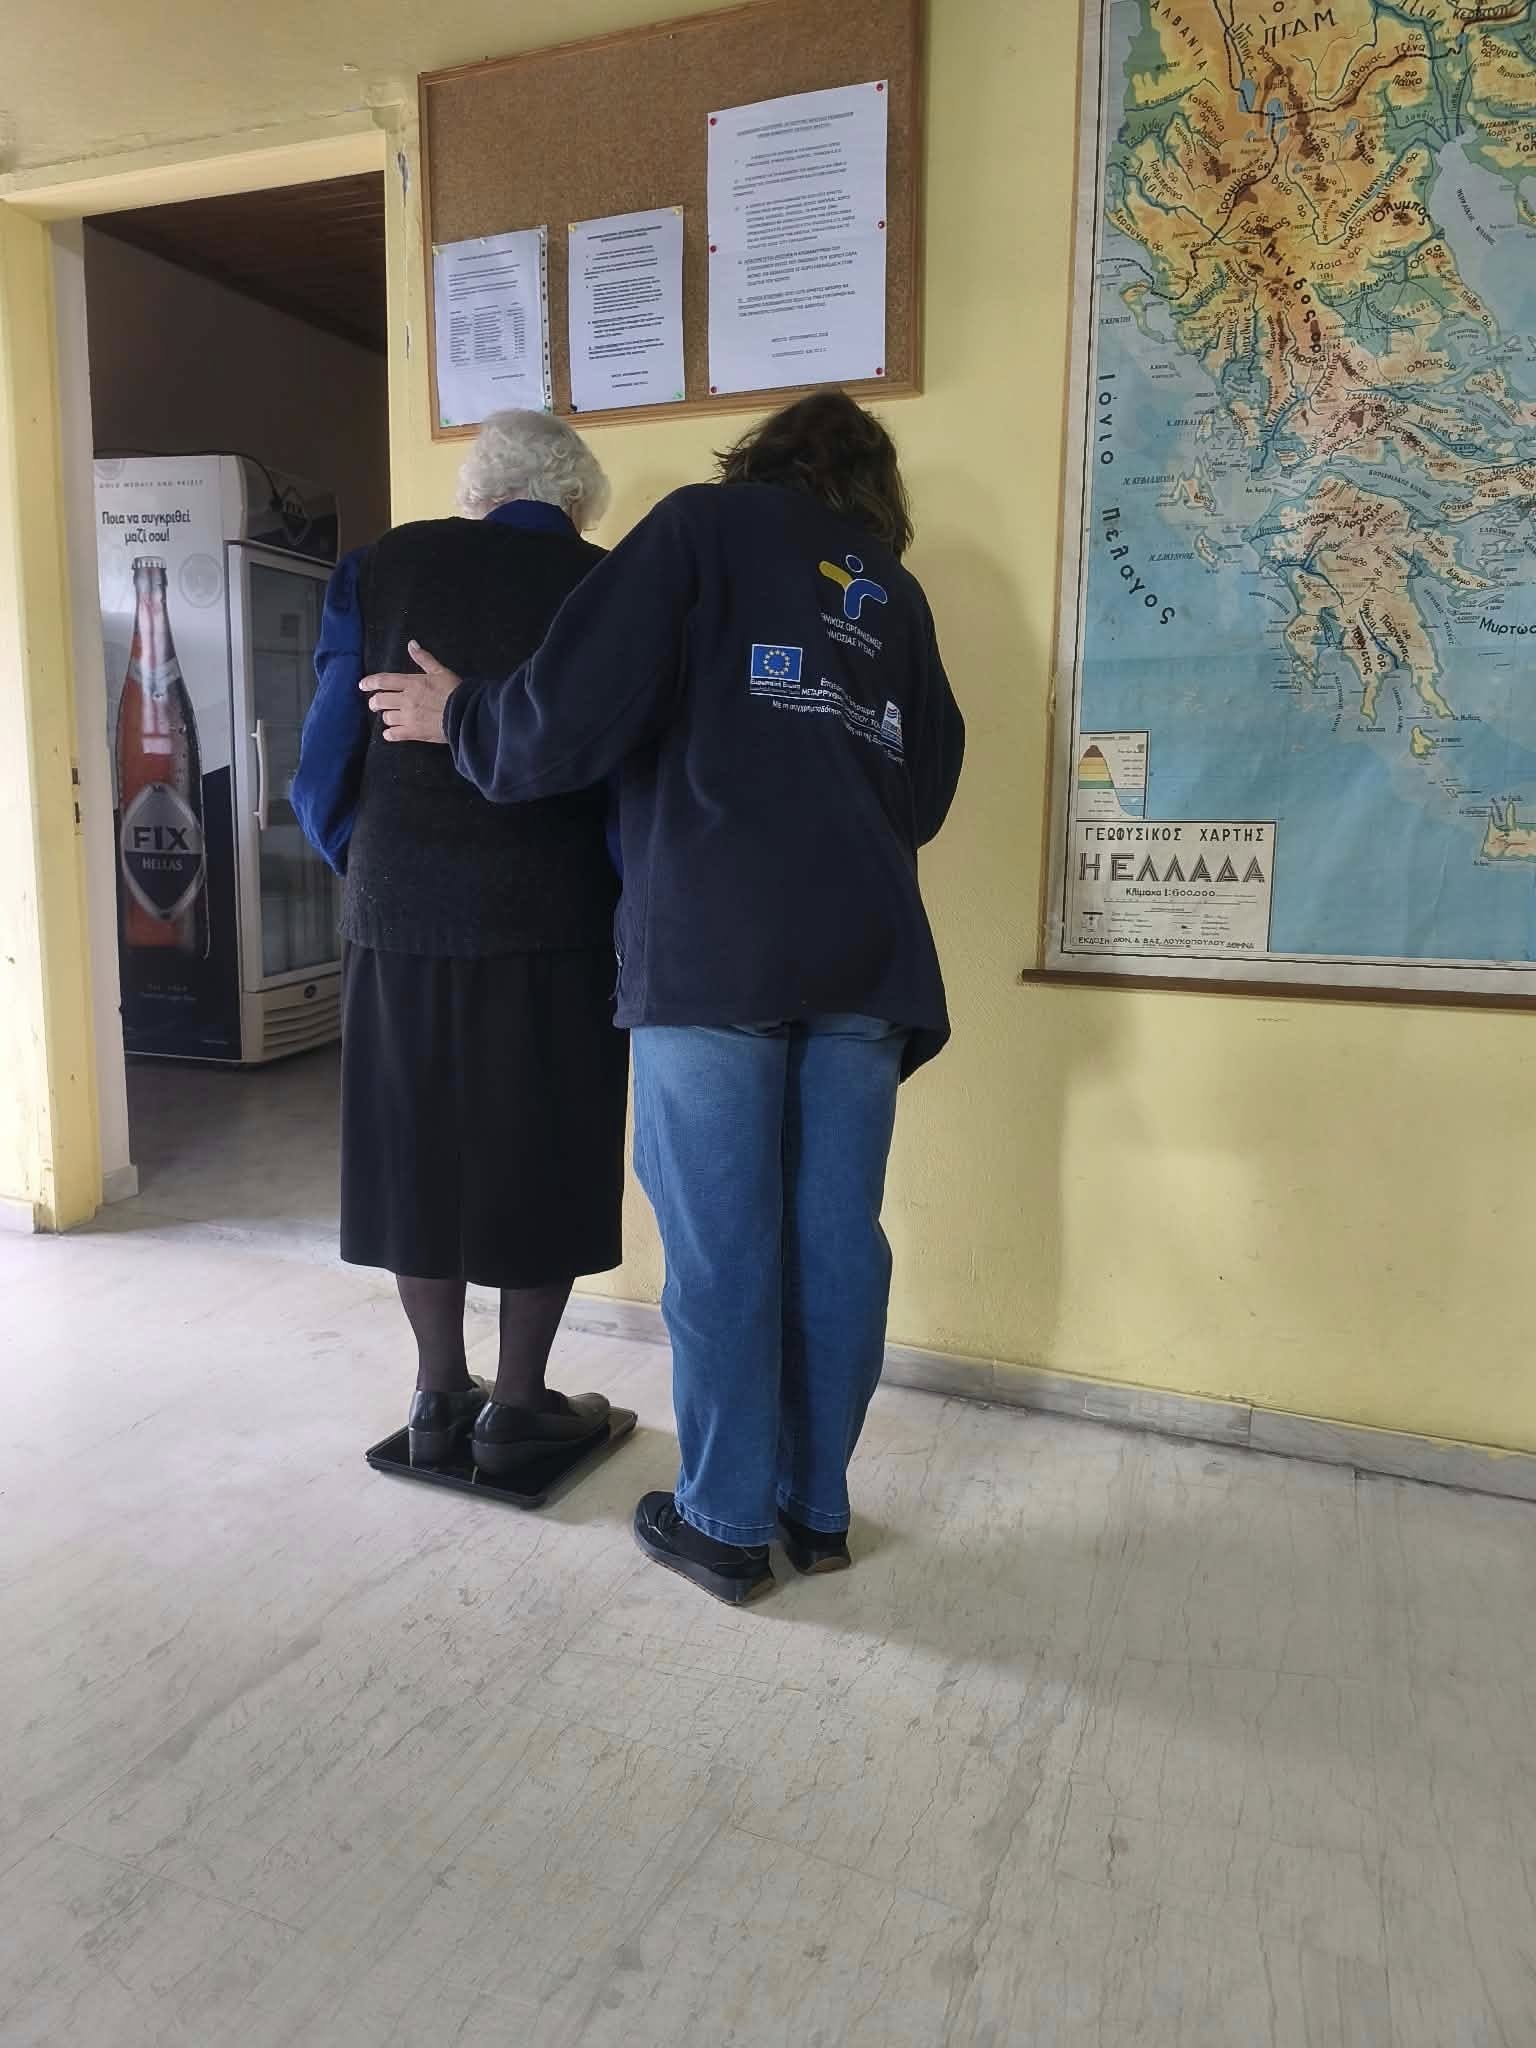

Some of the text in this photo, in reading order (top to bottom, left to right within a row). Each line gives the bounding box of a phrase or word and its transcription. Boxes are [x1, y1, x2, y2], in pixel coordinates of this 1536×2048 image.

[1150, 0, 1208, 72] ΑΛΒΑΝΙΑ
[102, 509, 192, 527] Ποια να συγκριθεί
[124, 528, 170, 546] μαζί σου!
[1102, 507, 1176, 625] Πέλαγος
[133, 826, 190, 851] FIX
[1085, 827, 1265, 842] ΓΕΩΦΥΣΙΚΟΣ ΧΑΡΤΗΣ
[142, 856, 184, 871] HELLAS
[1110, 853, 1266, 883] ΕΛΛΑΔΑ
